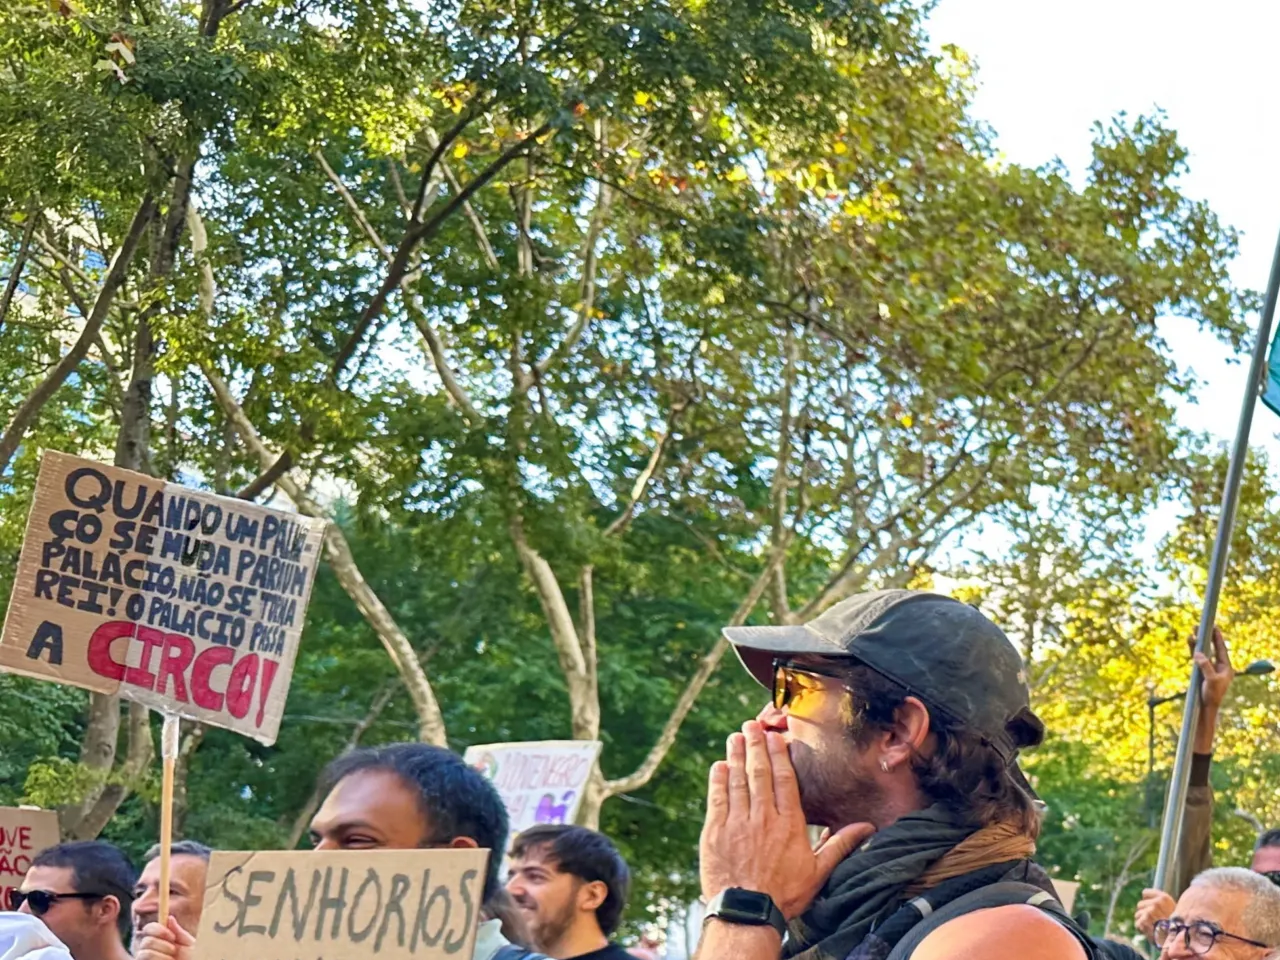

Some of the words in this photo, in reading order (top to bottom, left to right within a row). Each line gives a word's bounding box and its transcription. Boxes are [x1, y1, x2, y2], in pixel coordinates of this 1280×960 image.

[48, 509, 102, 546] ÇO
[109, 521, 159, 555] SE
[159, 530, 231, 576] MUDA
[64, 467, 222, 535] QUANDO
[226, 512, 259, 547] UM
[34, 569, 124, 616] REI!
[126, 593, 145, 621] O
[147, 596, 246, 647] PALÁCIO
[42, 542, 177, 599] PALÁCIO,
[178, 573, 225, 606] NÃO
[225, 585, 258, 616] SE
[26, 620, 63, 665] A
[88, 620, 279, 729] CIRCO!
[213, 865, 478, 954] SENHORIOS
